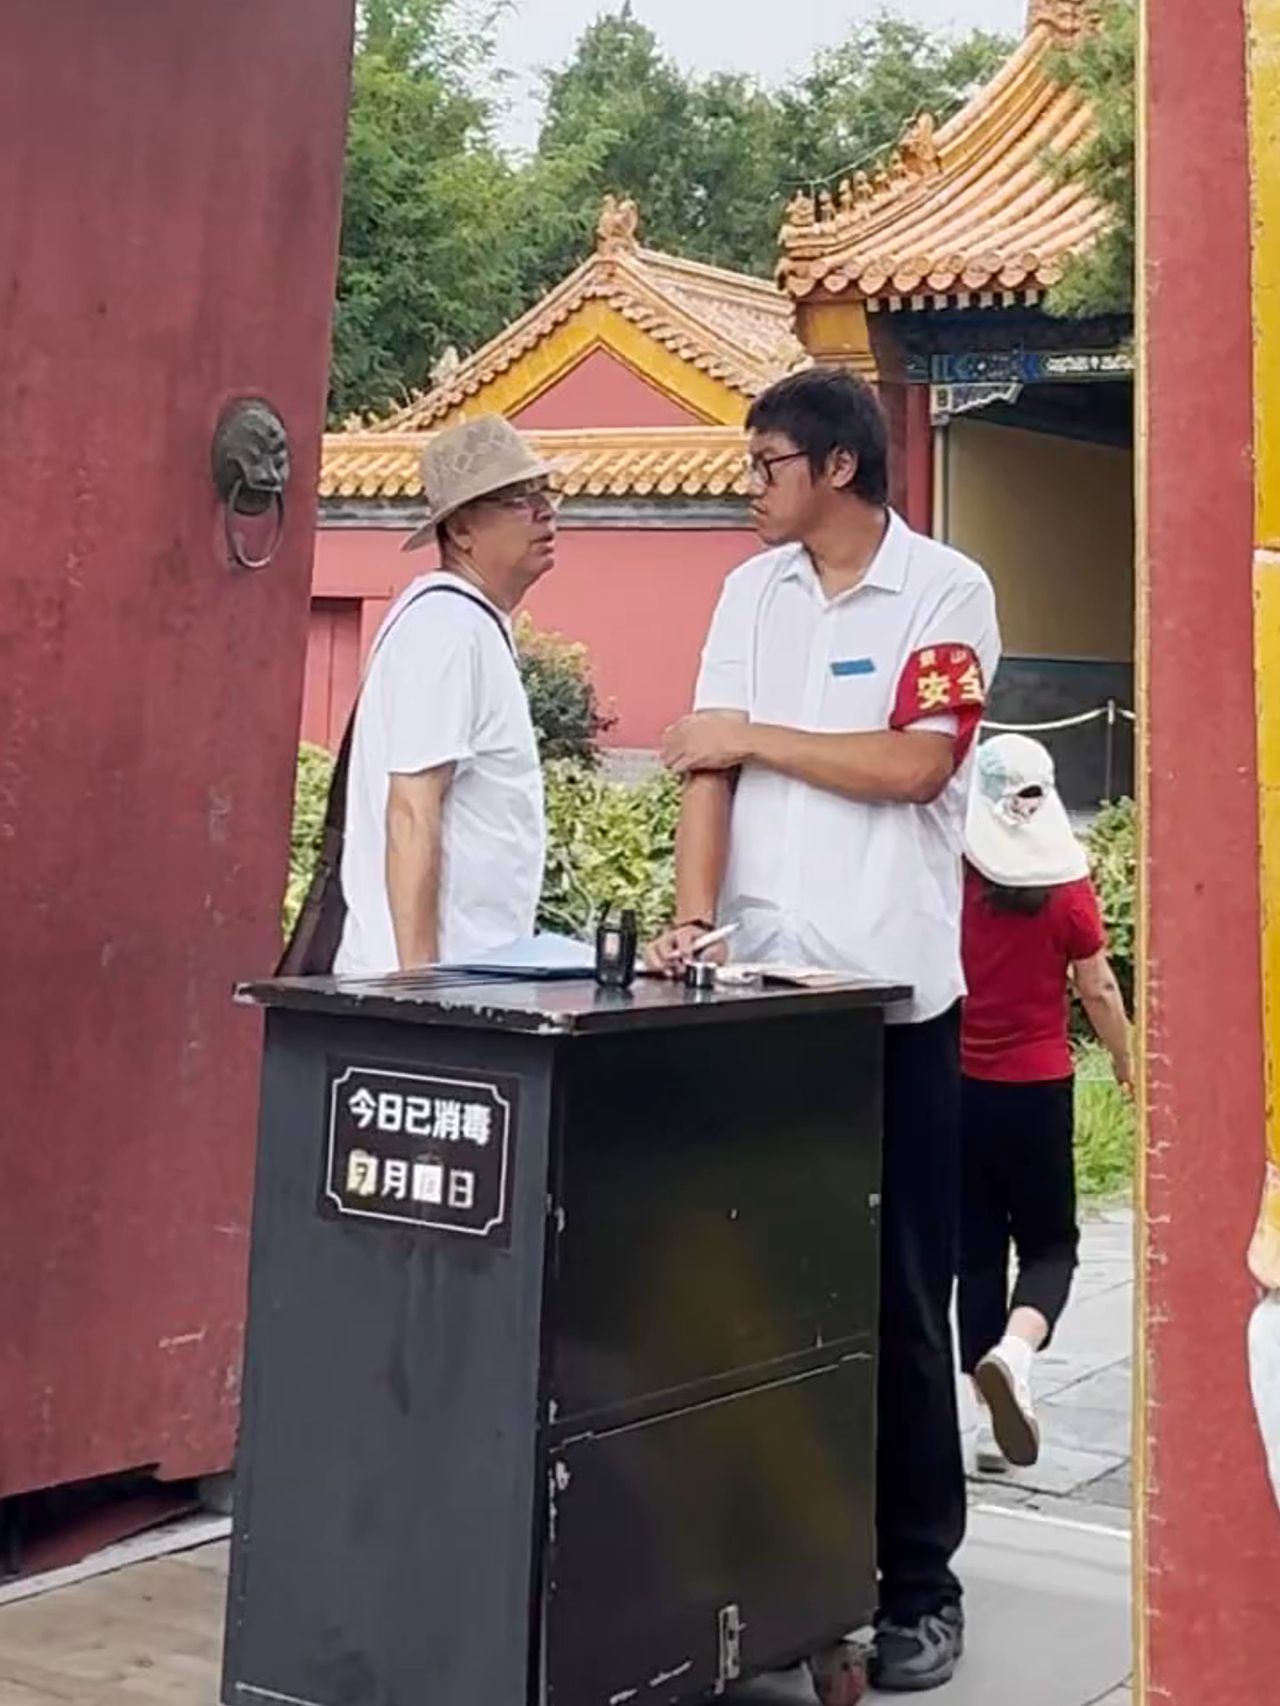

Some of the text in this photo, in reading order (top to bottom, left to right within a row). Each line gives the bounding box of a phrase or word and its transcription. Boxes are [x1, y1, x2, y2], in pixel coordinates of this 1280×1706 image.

[348, 1088, 491, 1145] 今日已消毒
